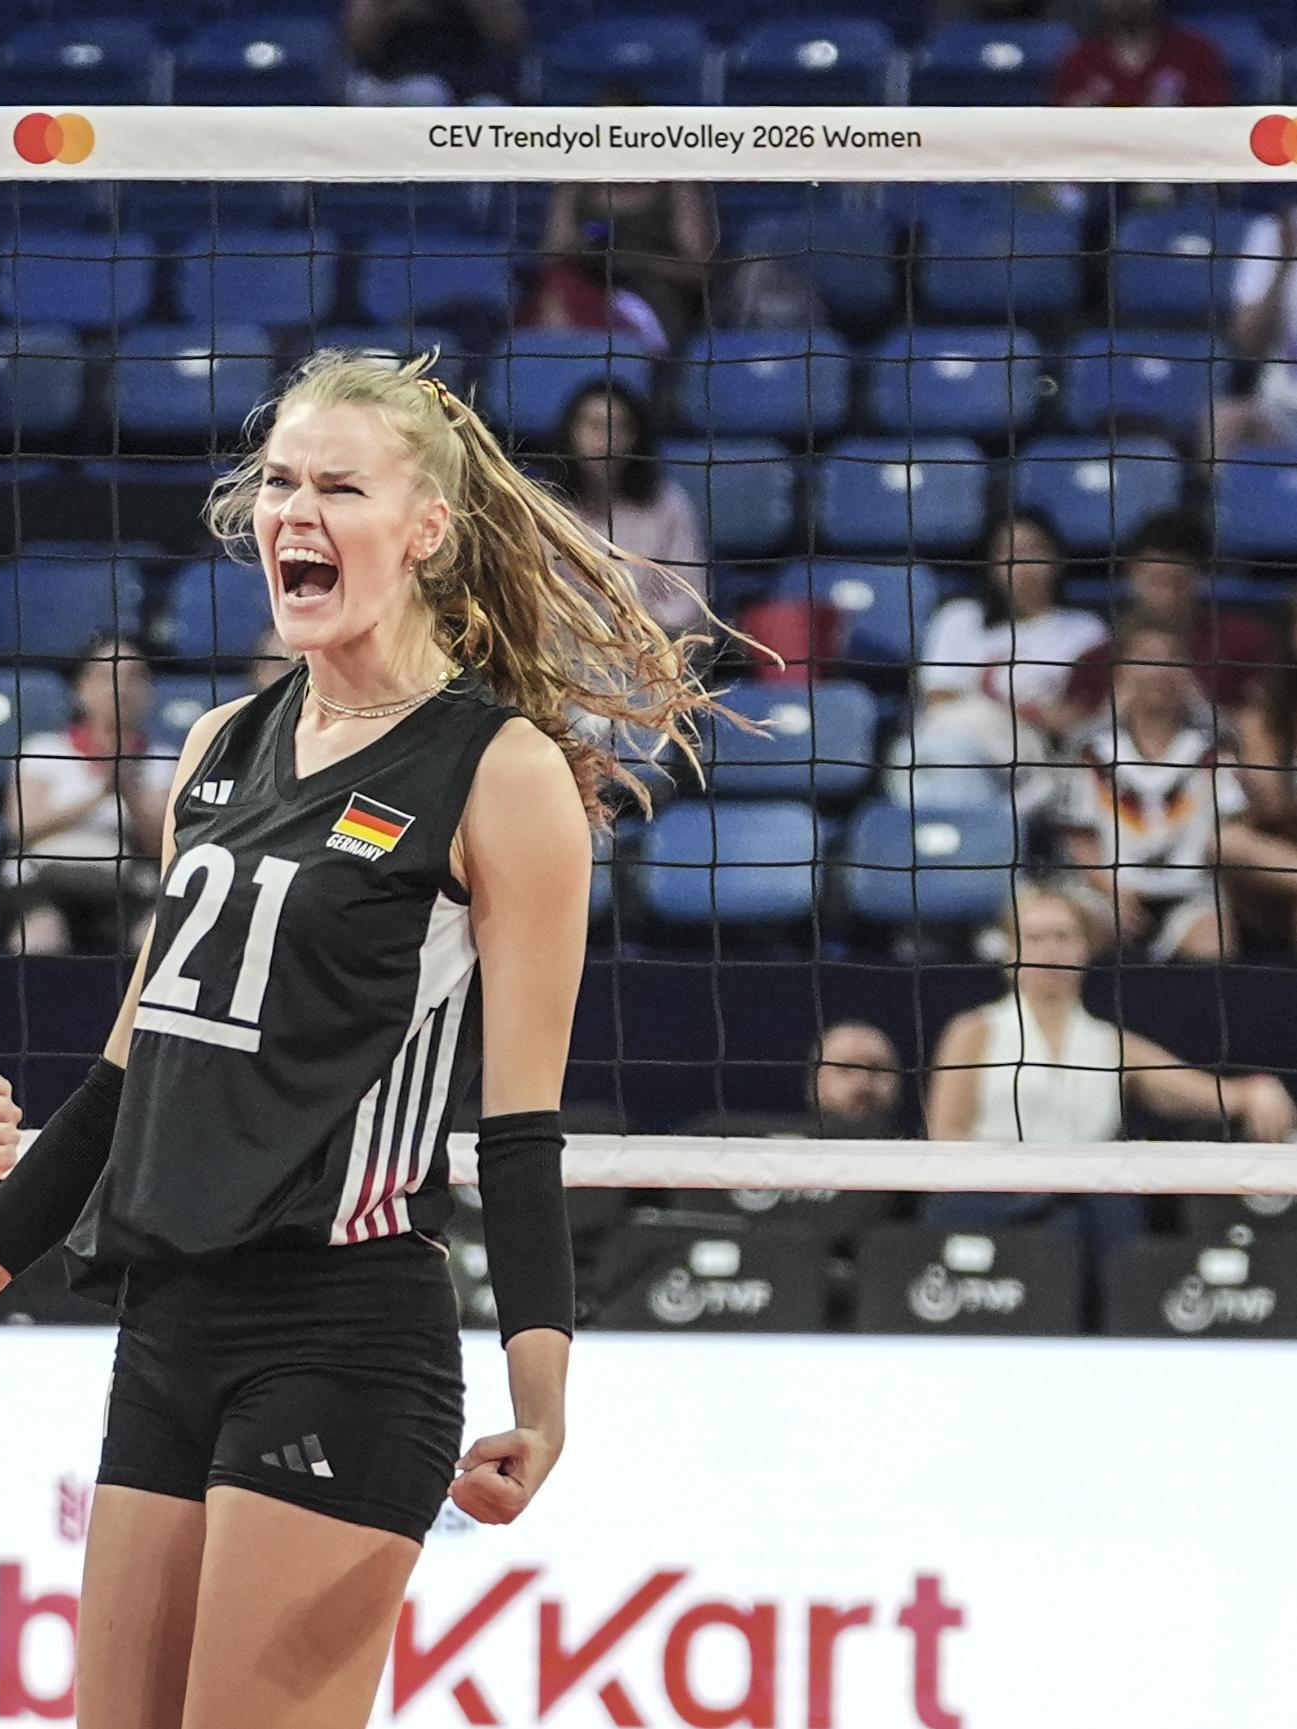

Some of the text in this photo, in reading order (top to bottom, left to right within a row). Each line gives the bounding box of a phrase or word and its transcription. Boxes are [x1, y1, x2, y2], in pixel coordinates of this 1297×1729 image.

[428, 123, 922, 154] CEV Trendyol EuroVolley 2026 Women
[325, 833, 386, 862] GERMANY
[138, 843, 301, 1024] 21
